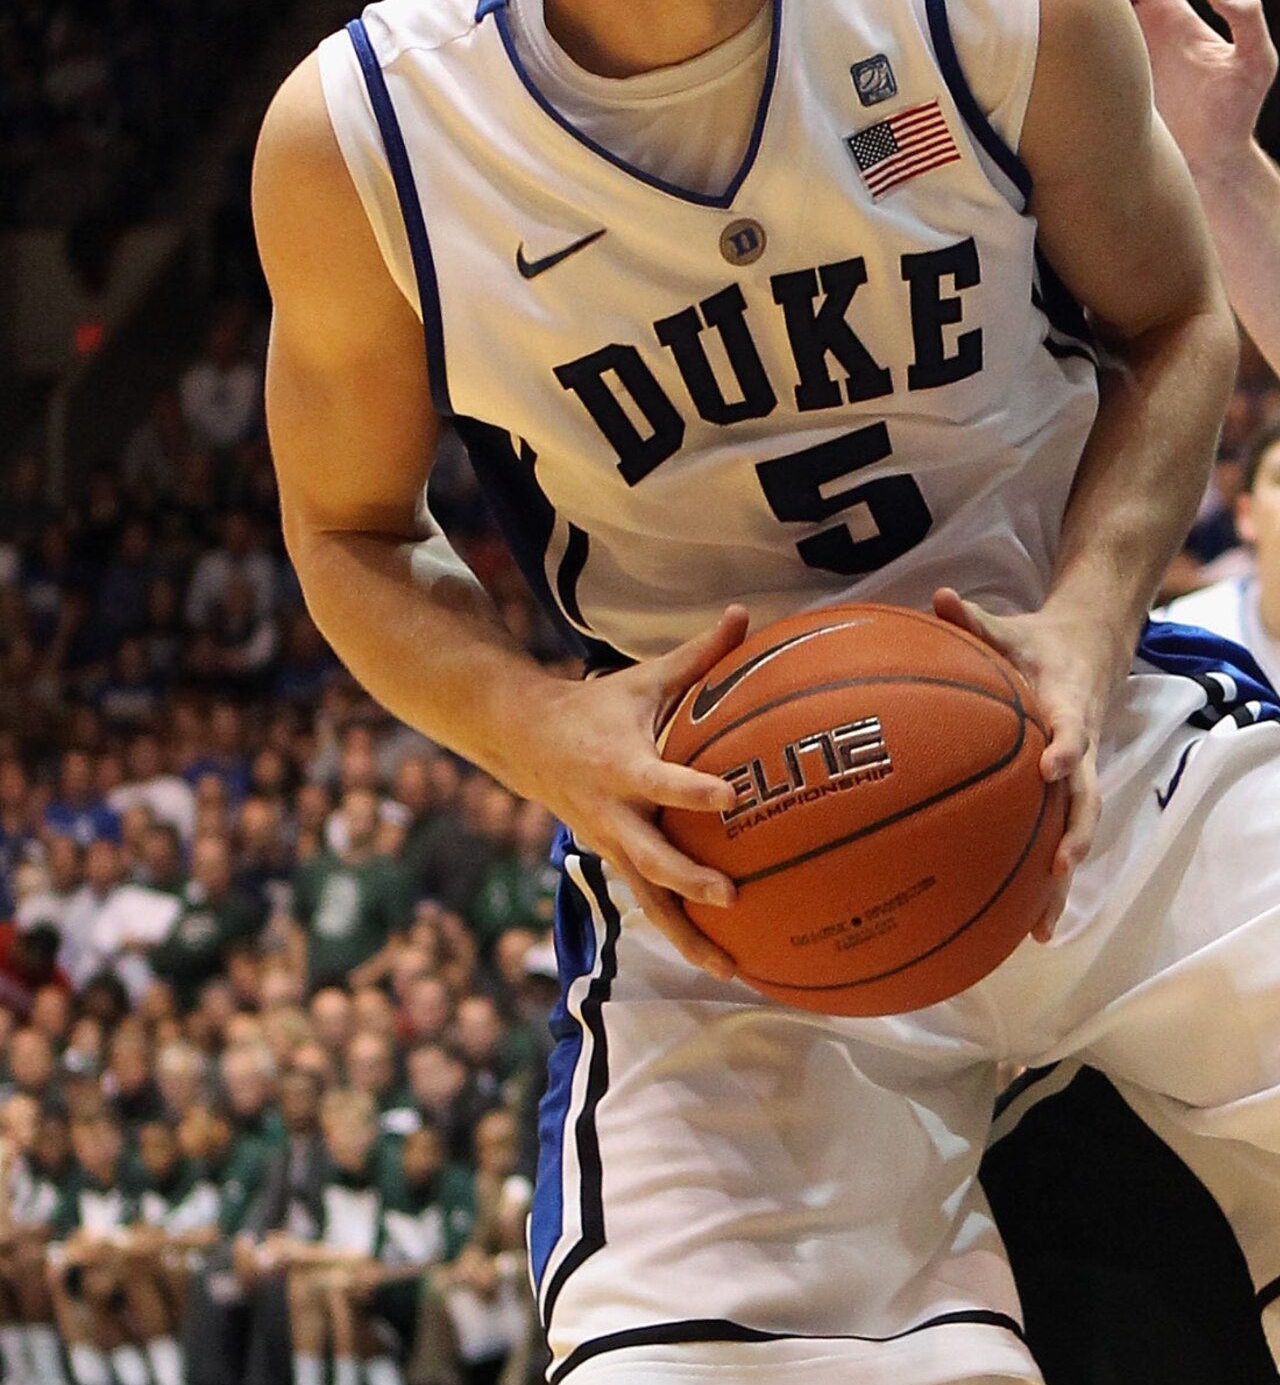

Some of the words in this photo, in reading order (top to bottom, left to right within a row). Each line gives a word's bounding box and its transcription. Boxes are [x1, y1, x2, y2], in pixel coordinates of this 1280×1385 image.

[552, 236, 985, 488] DUKE
[755, 421, 933, 576] 5
[720, 716, 891, 824] ELITE
[726, 766, 894, 840] CHAMPIONSHIP
